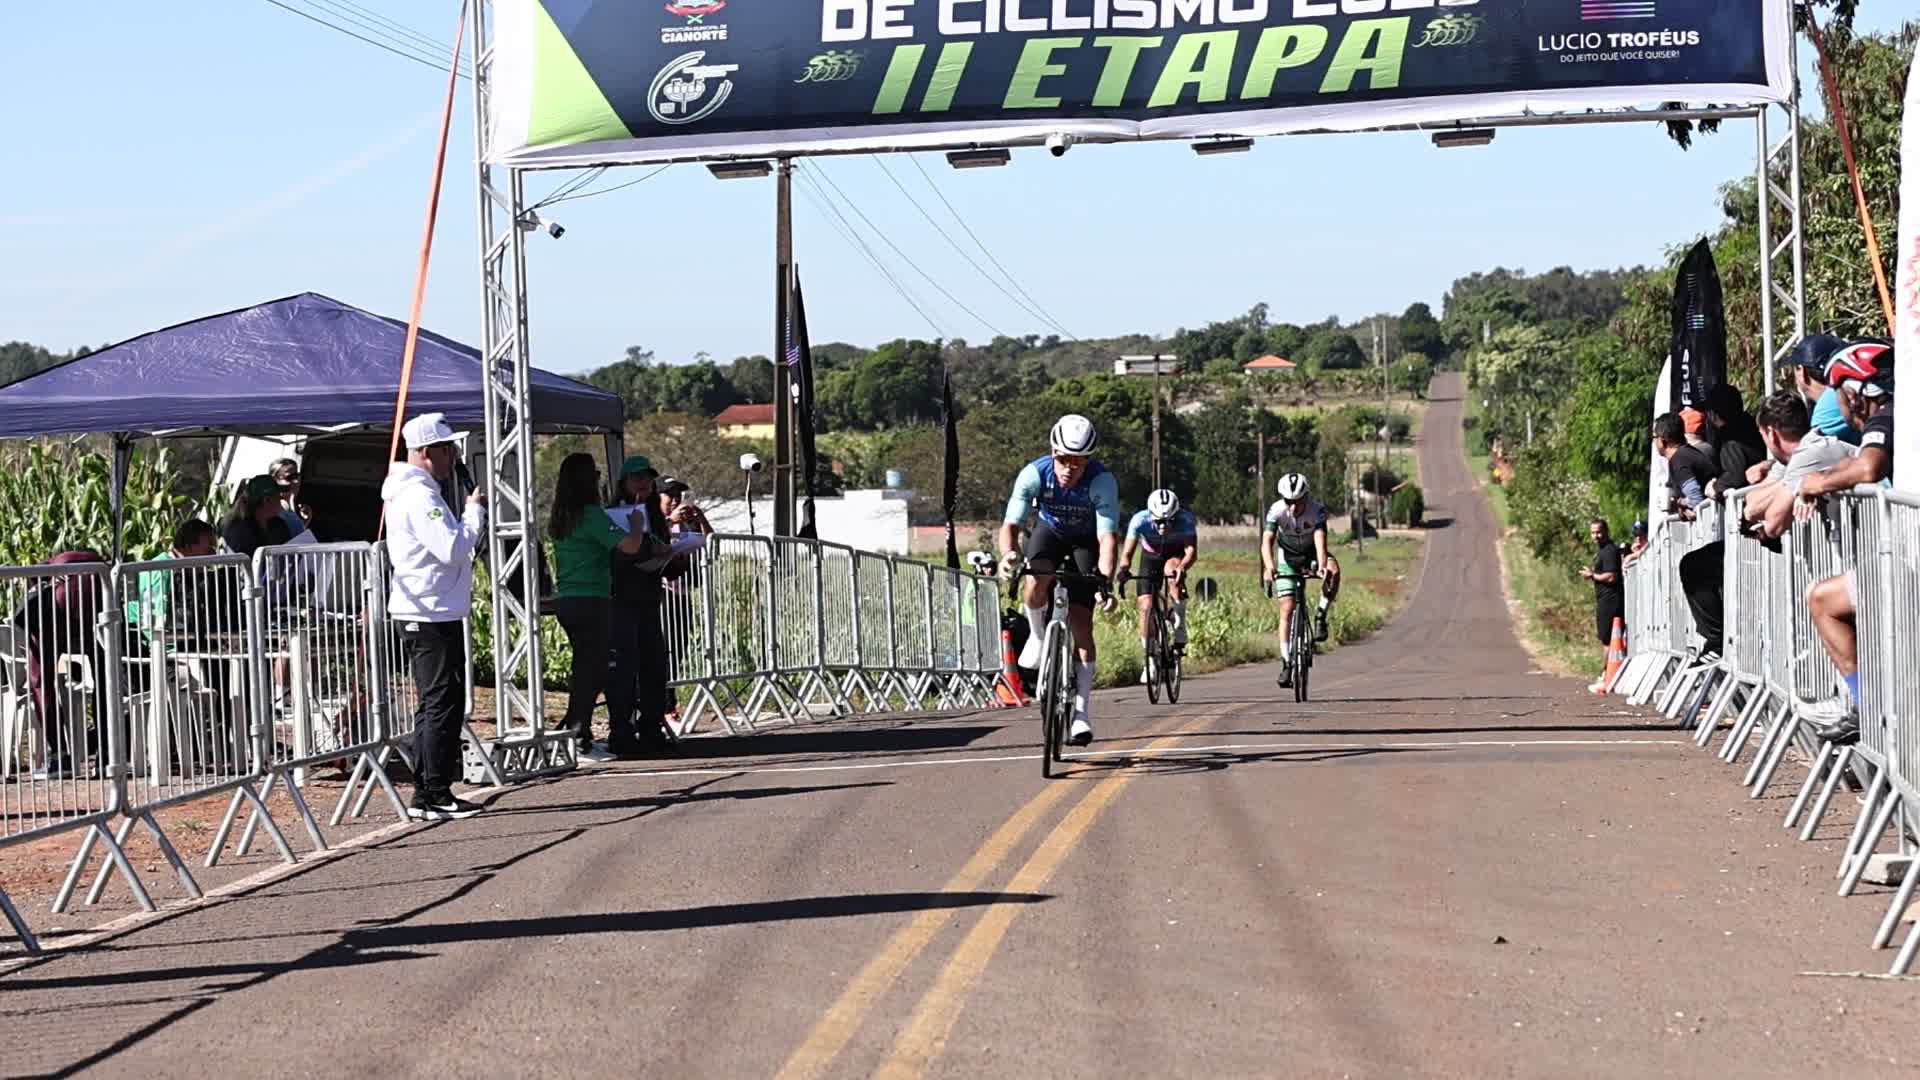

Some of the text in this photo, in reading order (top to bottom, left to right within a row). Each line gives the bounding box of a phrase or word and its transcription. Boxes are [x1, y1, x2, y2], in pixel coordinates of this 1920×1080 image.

[821, 0, 914, 42] DE
[661, 30, 728, 43] CIANORTE
[1538, 28, 1700, 51] LUCIO TROFÉUS
[871, 15, 1411, 114] II ETAPA
[1560, 54, 1574, 63] DO
[1575, 53, 1599, 62] JEITO
[1600, 52, 1619, 61] QUE
[1645, 50, 1680, 59] QUISER!
